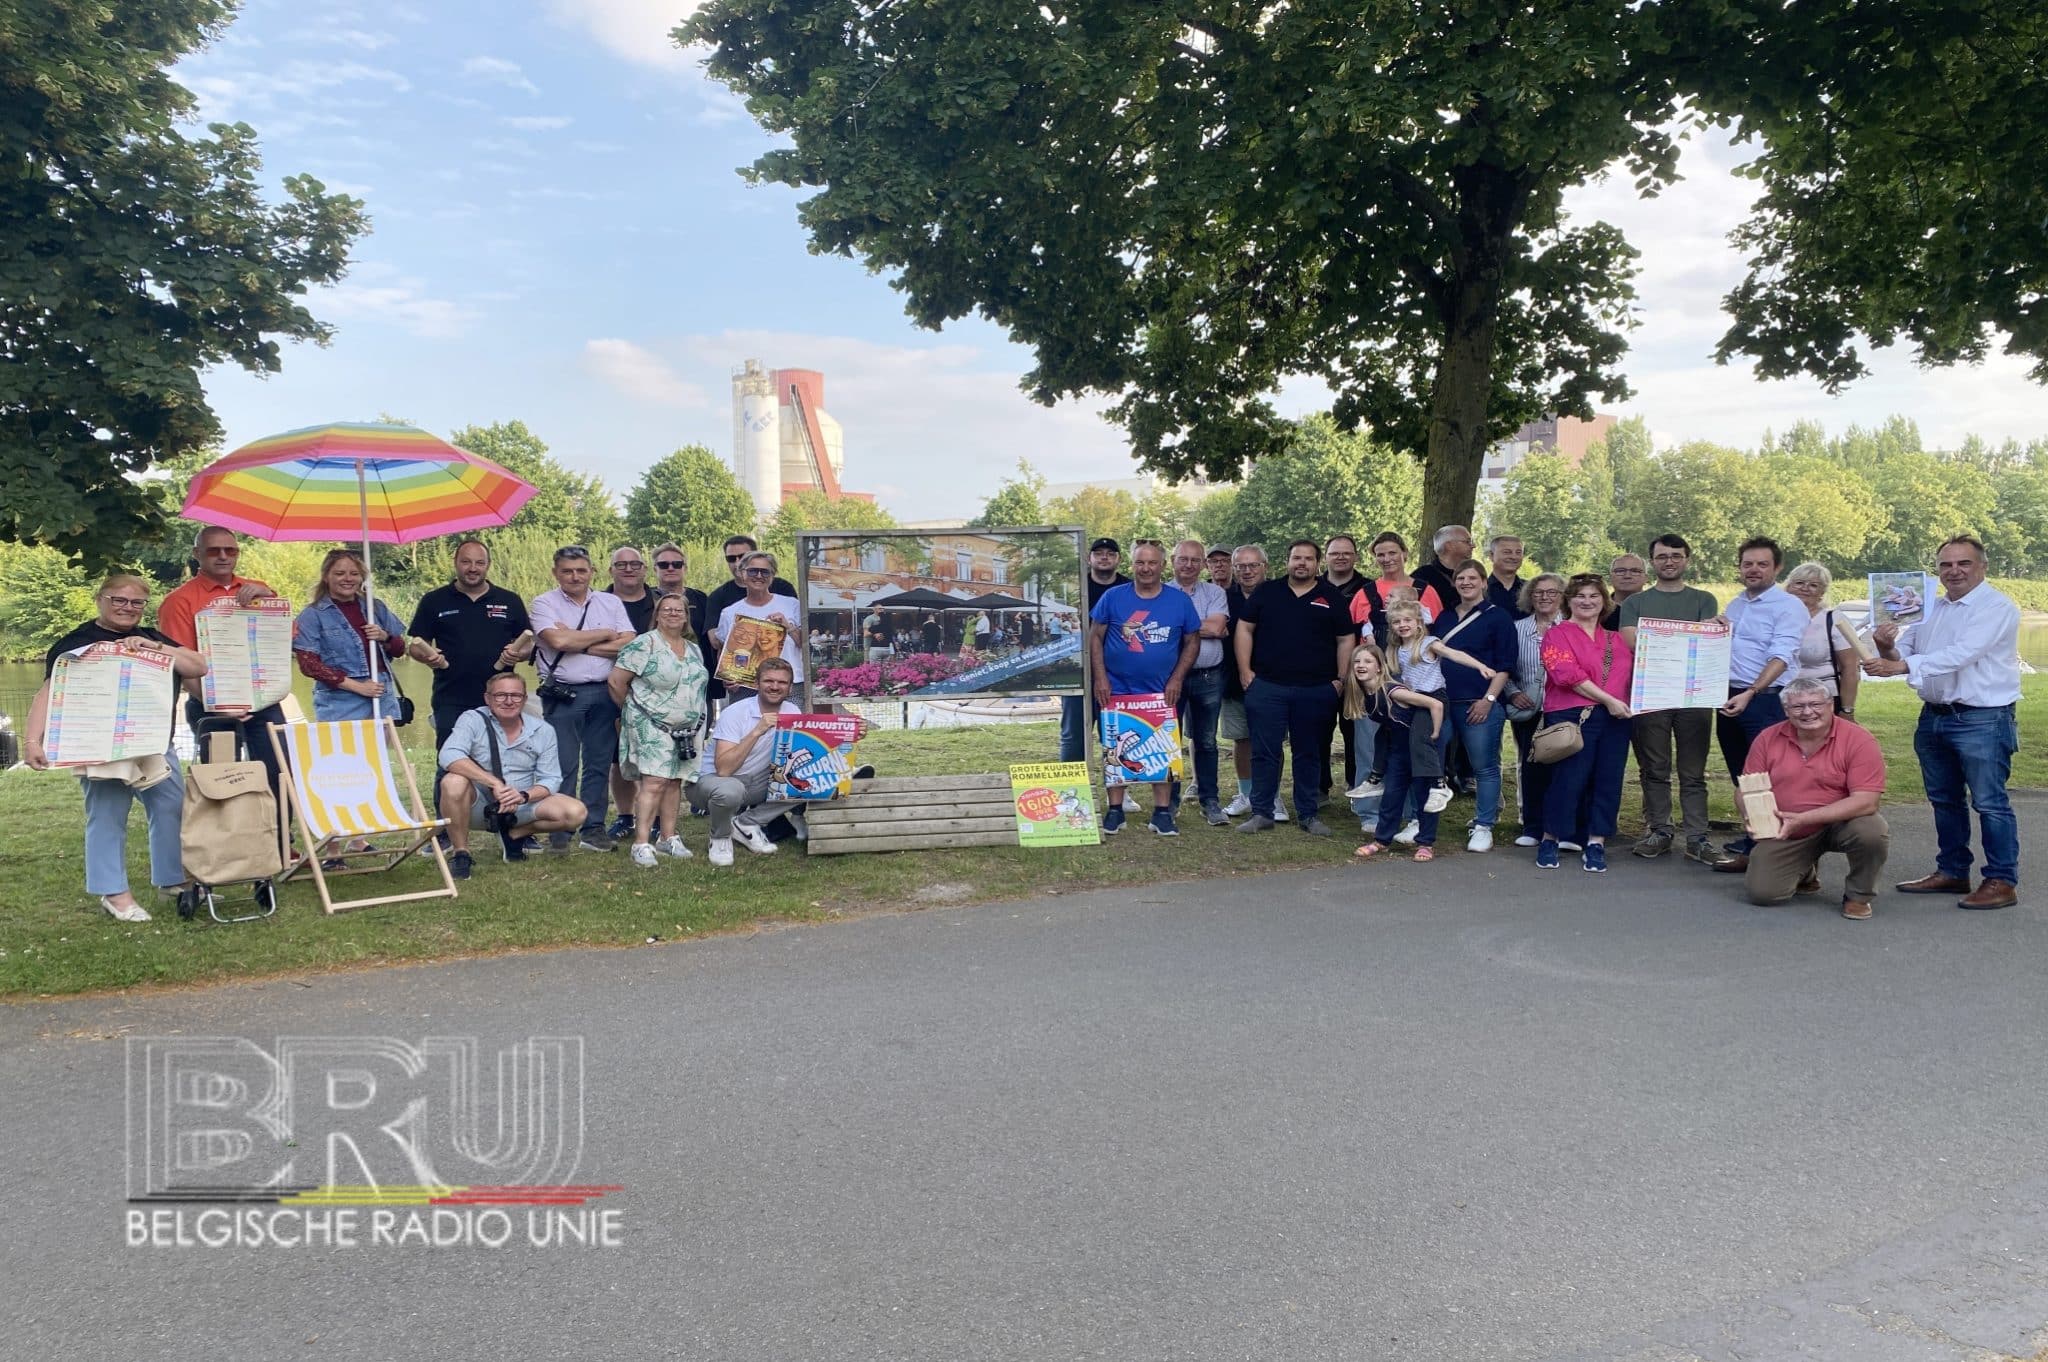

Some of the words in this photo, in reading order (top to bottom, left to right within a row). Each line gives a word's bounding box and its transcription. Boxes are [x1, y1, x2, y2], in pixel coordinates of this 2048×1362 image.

[247, 598, 289, 608] OMERT
[1641, 619, 1685, 630] KUURNE
[959, 667, 989, 682] Geniet,
[988, 661, 1010, 673] koop
[1010, 655, 1021, 664] en
[1115, 701, 1126, 710] 14
[1127, 699, 1169, 710] AUGUSTU
[792, 720, 803, 729] 14
[804, 720, 856, 731] AUGUSTUS
[1011, 765, 1041, 773] GROTE
[1044, 763, 1086, 772] KUURNSE
[1012, 770, 1087, 780] ROMMELMARKT
[1018, 793, 1061, 813] 16/08
